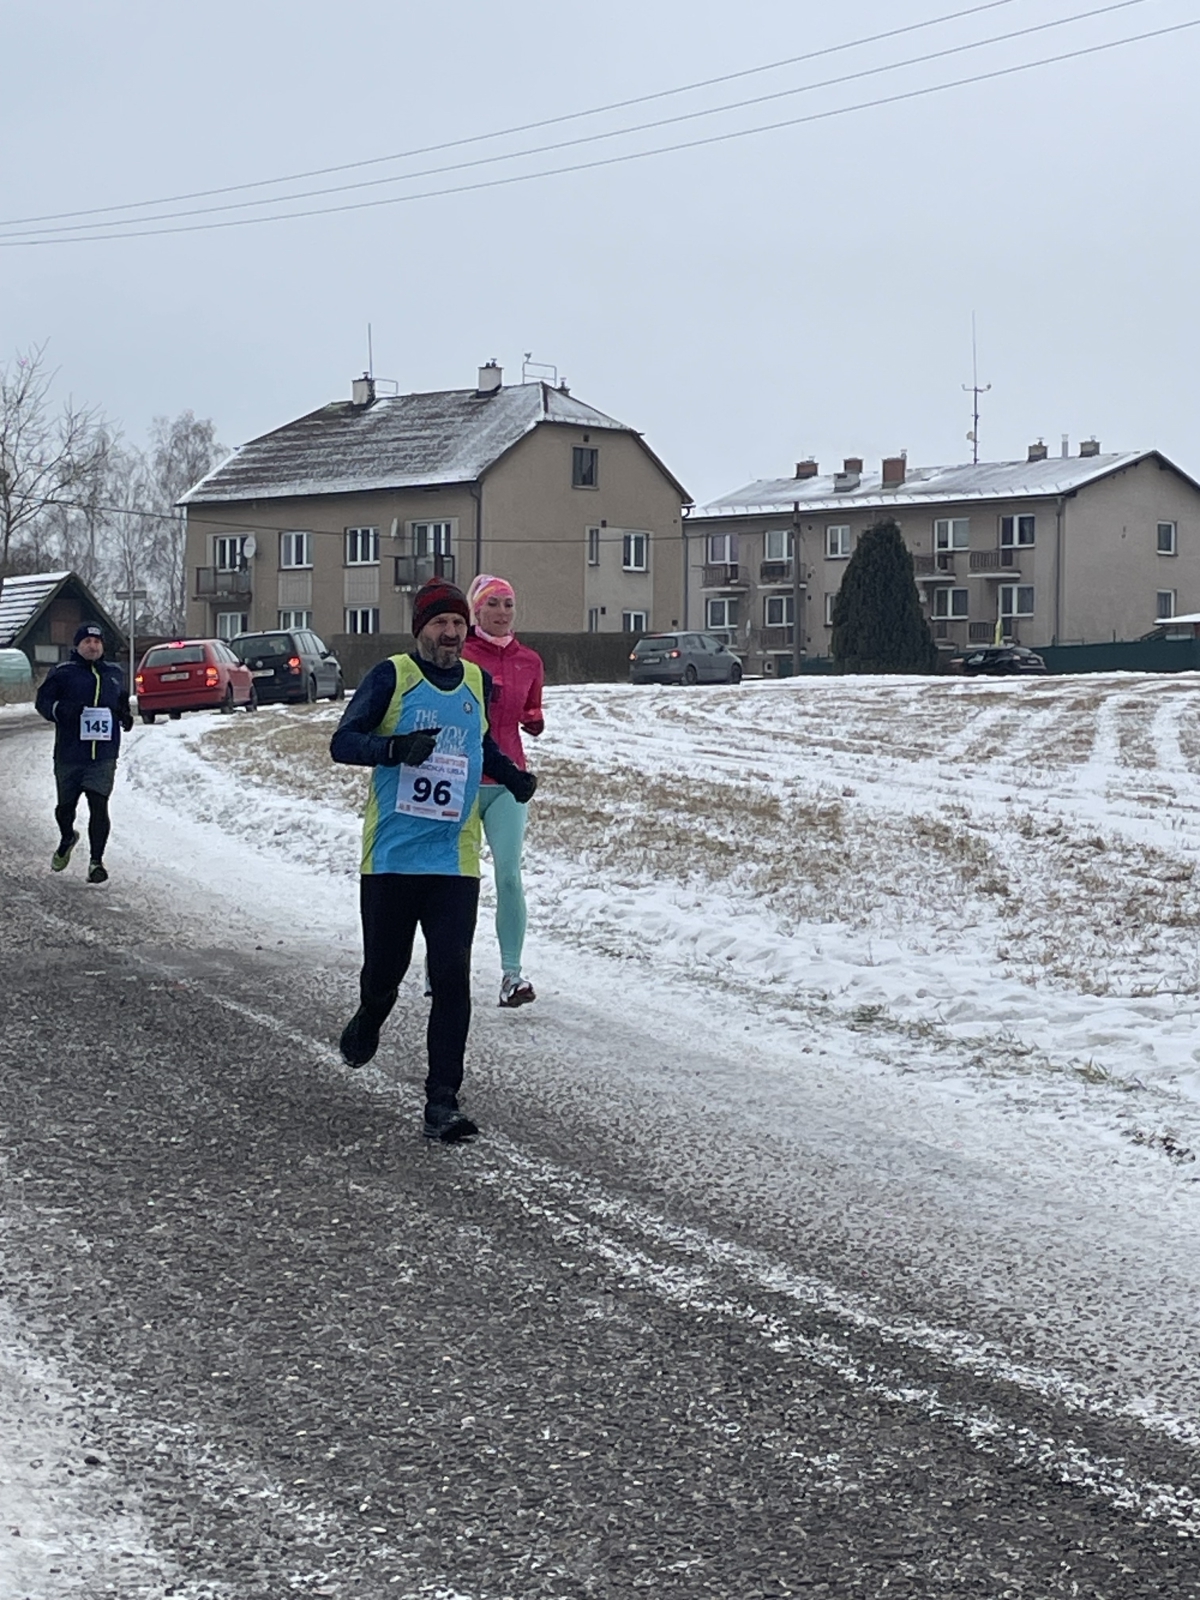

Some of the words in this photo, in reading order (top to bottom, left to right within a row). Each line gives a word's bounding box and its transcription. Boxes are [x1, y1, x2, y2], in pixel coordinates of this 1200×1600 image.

[415, 709, 438, 723] THE
[84, 720, 109, 733] 145
[412, 777, 452, 806] 96
